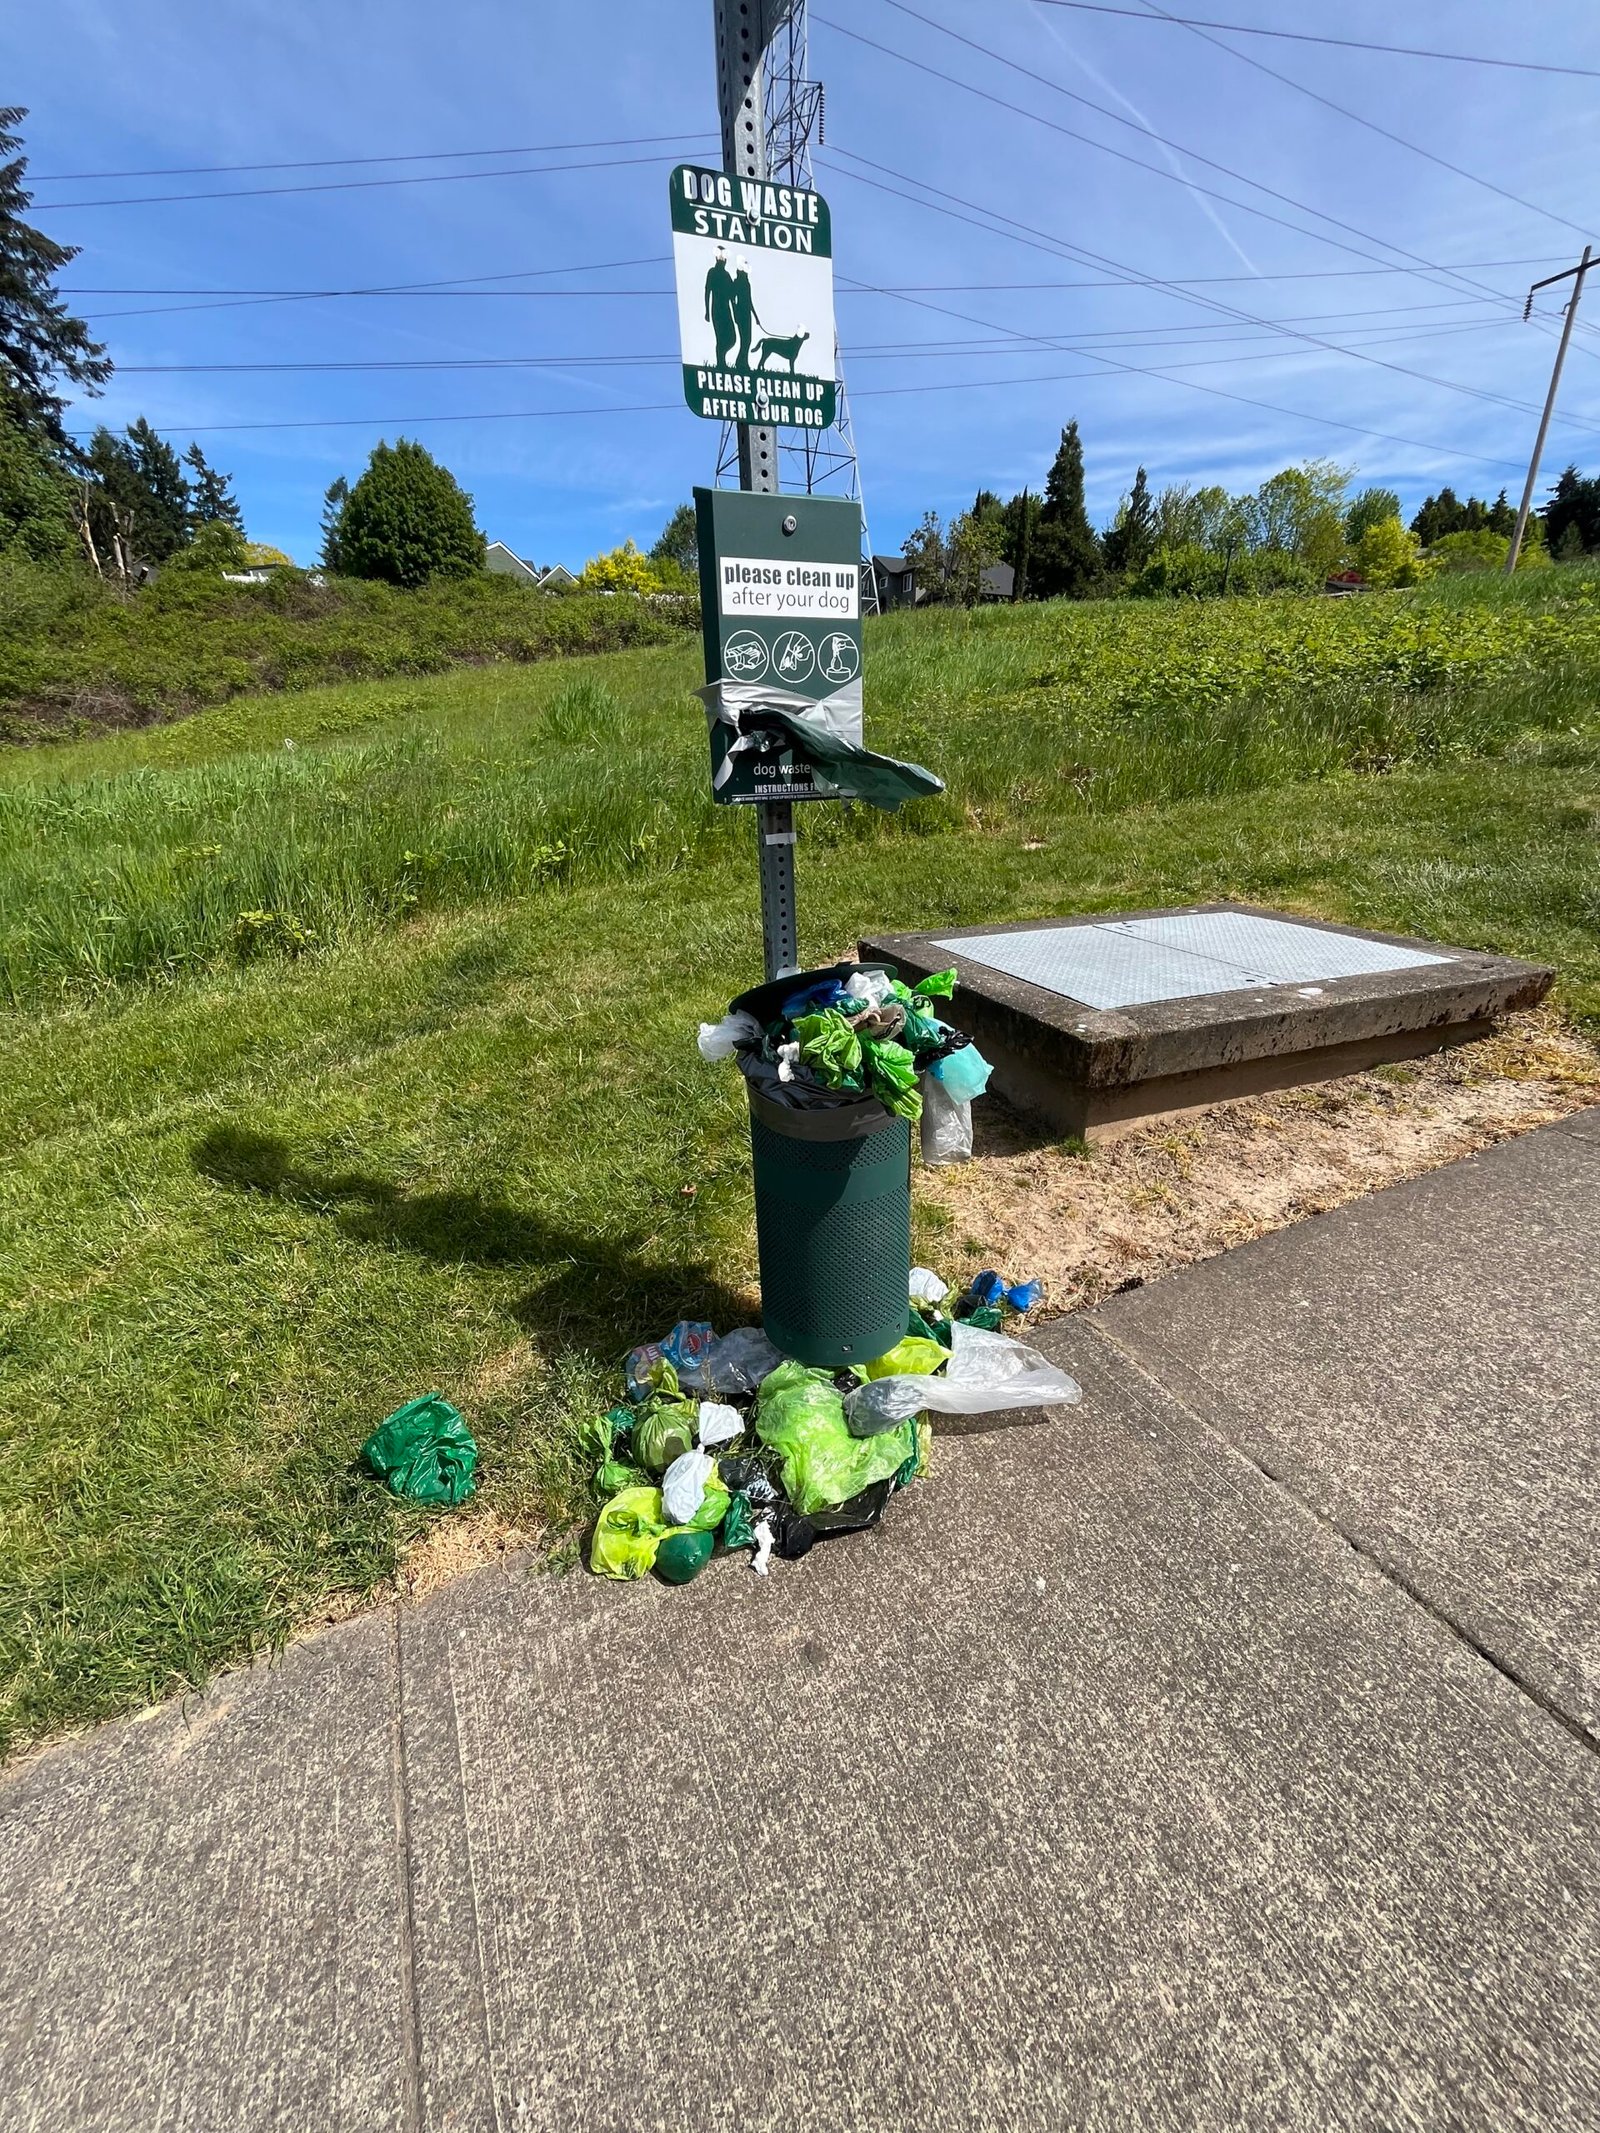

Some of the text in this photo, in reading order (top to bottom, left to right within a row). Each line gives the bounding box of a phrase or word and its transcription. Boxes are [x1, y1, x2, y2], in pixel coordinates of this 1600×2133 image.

[682, 169, 819, 224] DOG WASTE
[694, 209, 812, 253] STATION
[697, 370, 824, 402] PLEASE CLEAN UP
[702, 397, 823, 426] AFTER YOUR DOG
[725, 563, 855, 591] please clean up
[732, 586, 849, 614] after your dog
[753, 762, 811, 778] dog waste
[754, 782, 809, 794] INSTRUCTIONS
